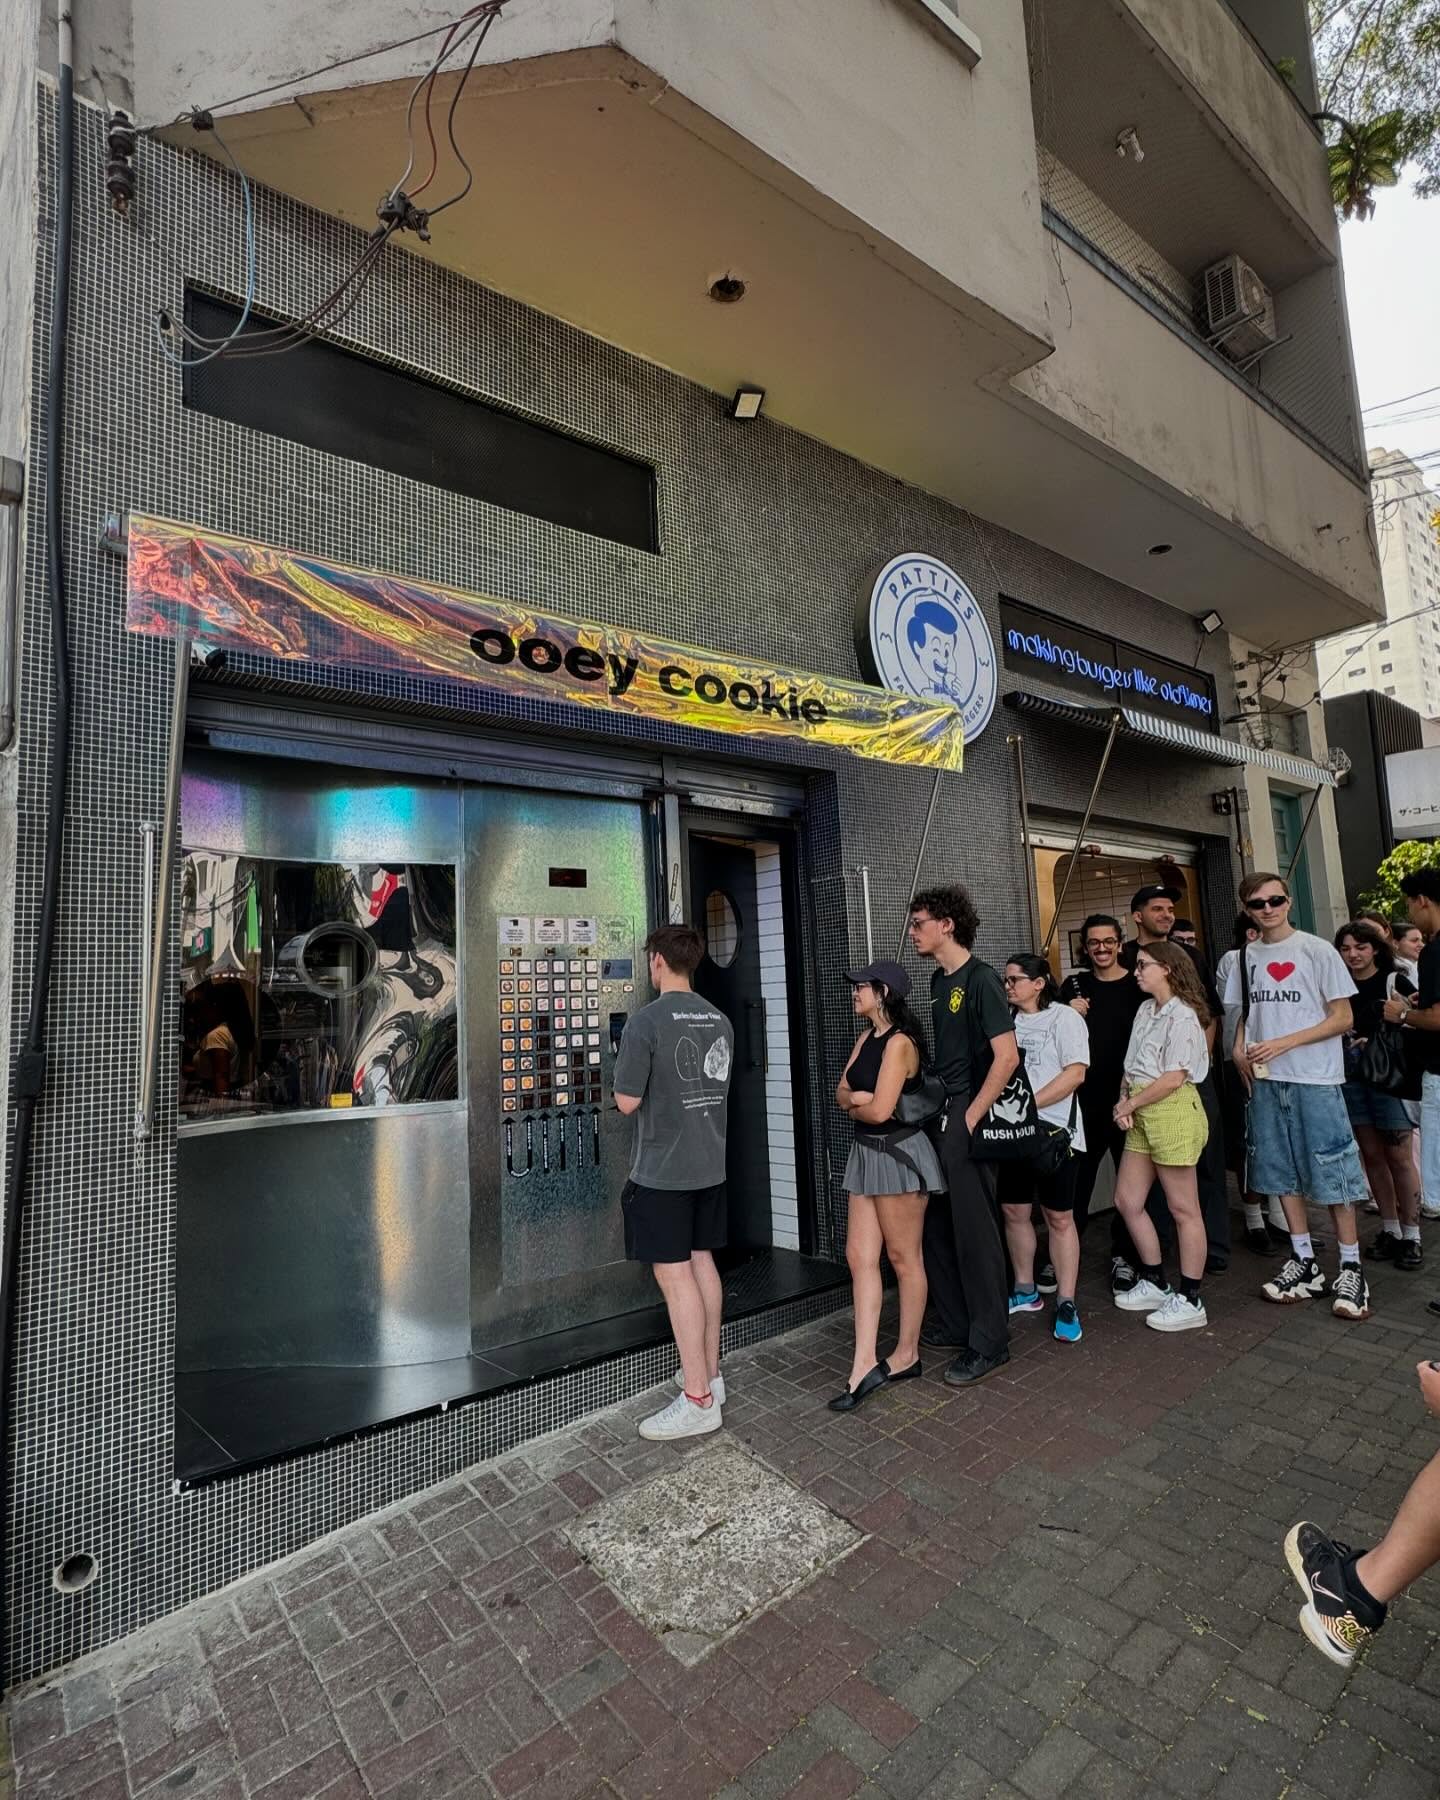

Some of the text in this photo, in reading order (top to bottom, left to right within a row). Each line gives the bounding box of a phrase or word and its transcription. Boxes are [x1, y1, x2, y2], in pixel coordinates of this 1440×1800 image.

[889, 567, 974, 620] PATTIES
[1008, 629, 1075, 673] making
[469, 628, 829, 725] ooey cookie
[963, 694, 984, 727] RGERS
[1250, 964, 1257, 985] I
[983, 1129, 1014, 1140] RUSH
